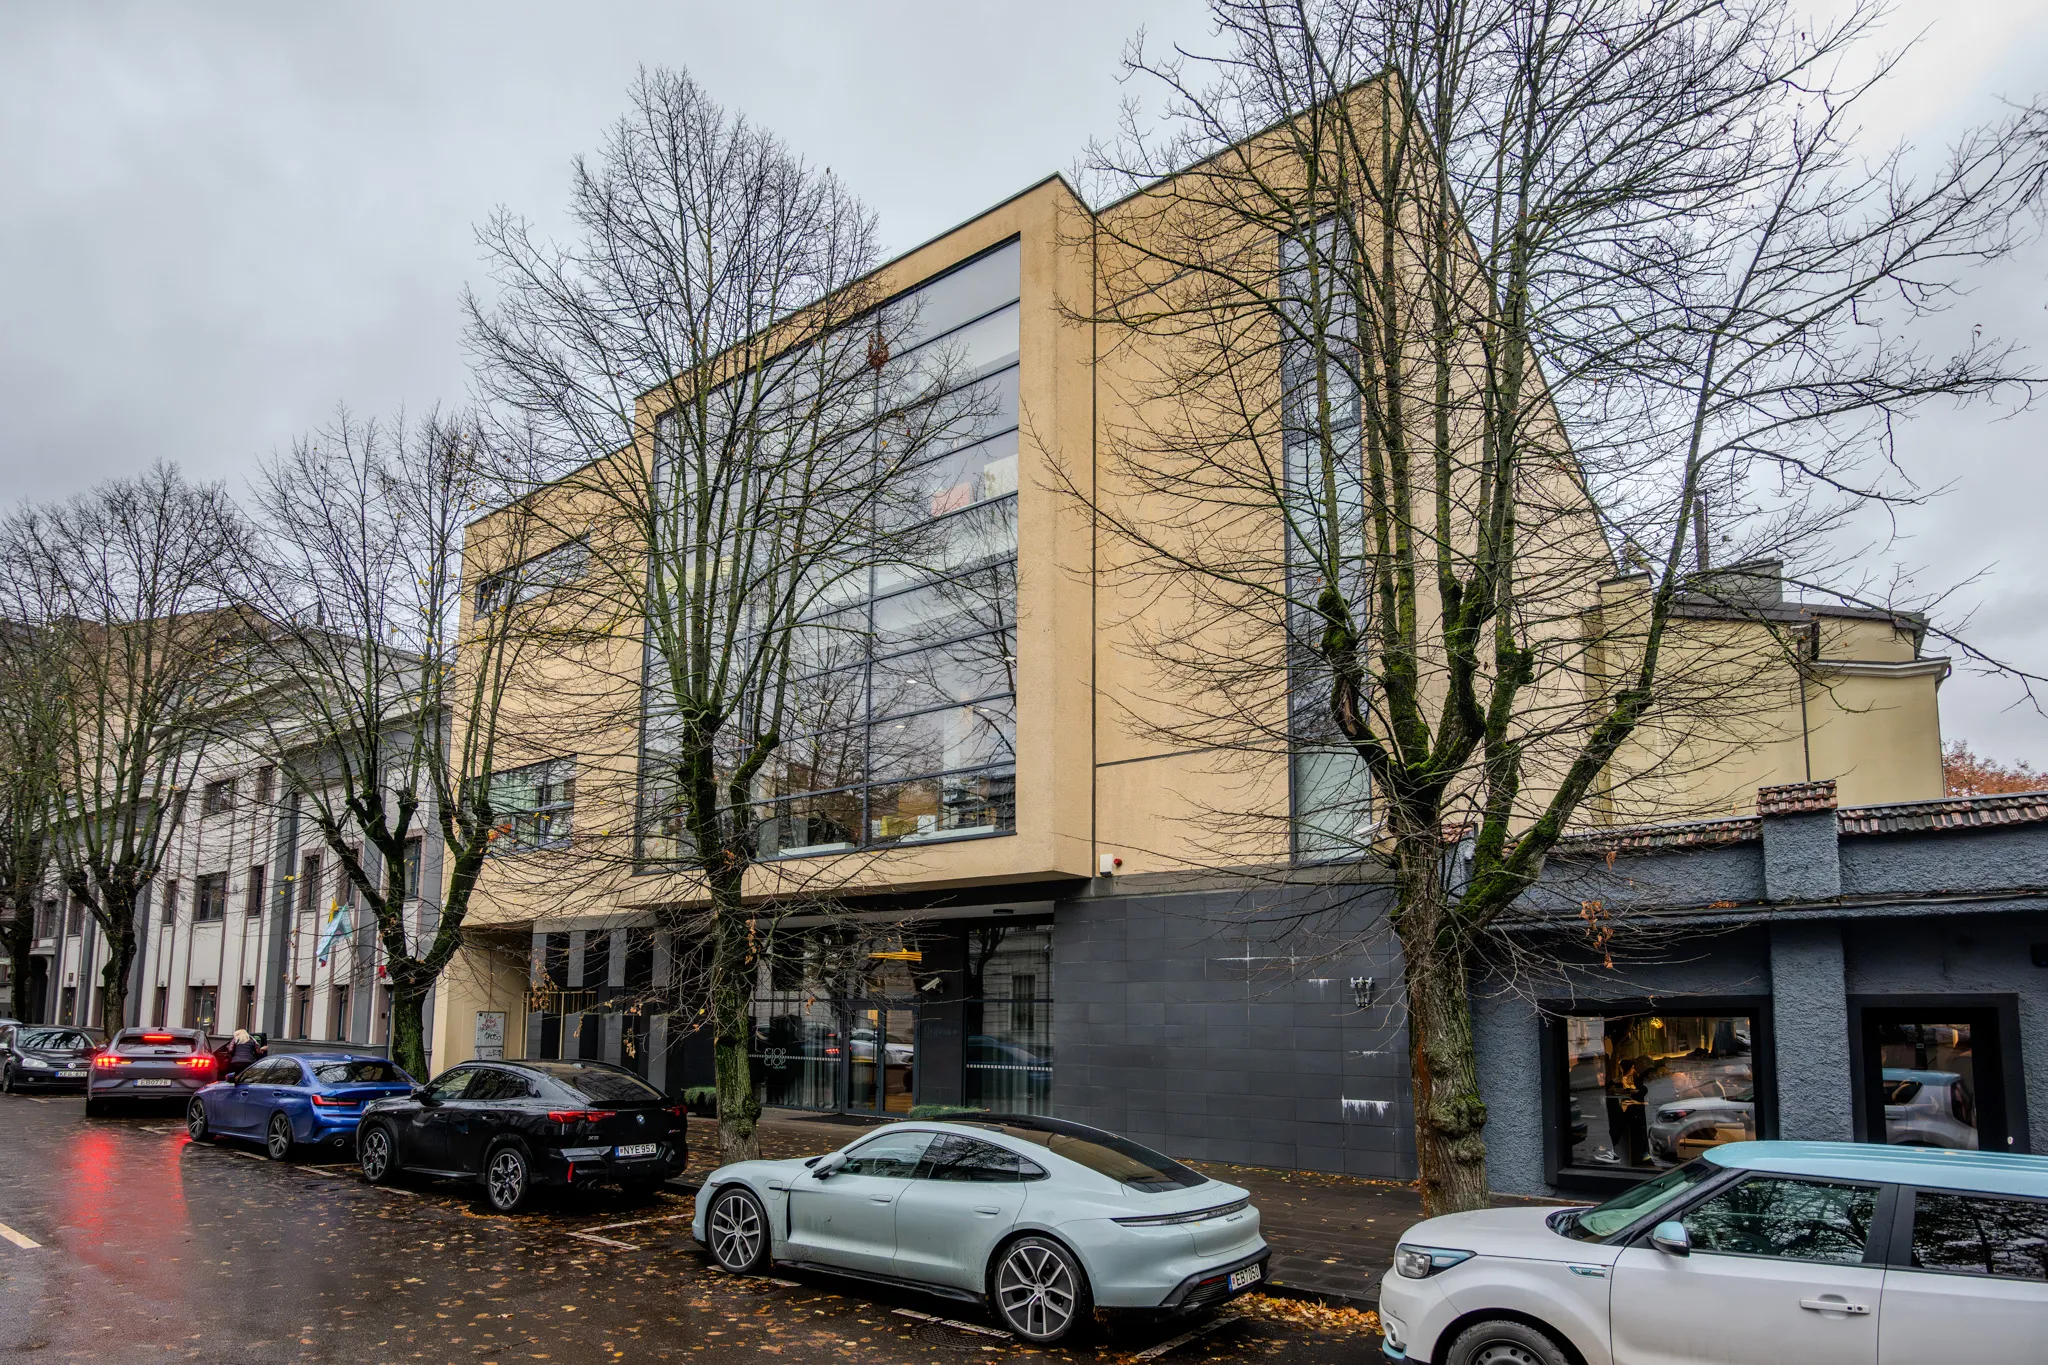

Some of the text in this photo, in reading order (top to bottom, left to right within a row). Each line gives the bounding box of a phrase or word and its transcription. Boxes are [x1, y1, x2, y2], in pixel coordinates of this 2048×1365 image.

[623, 1144, 655, 1155] NYE 952
[1235, 1265, 1260, 1286] EB7050
